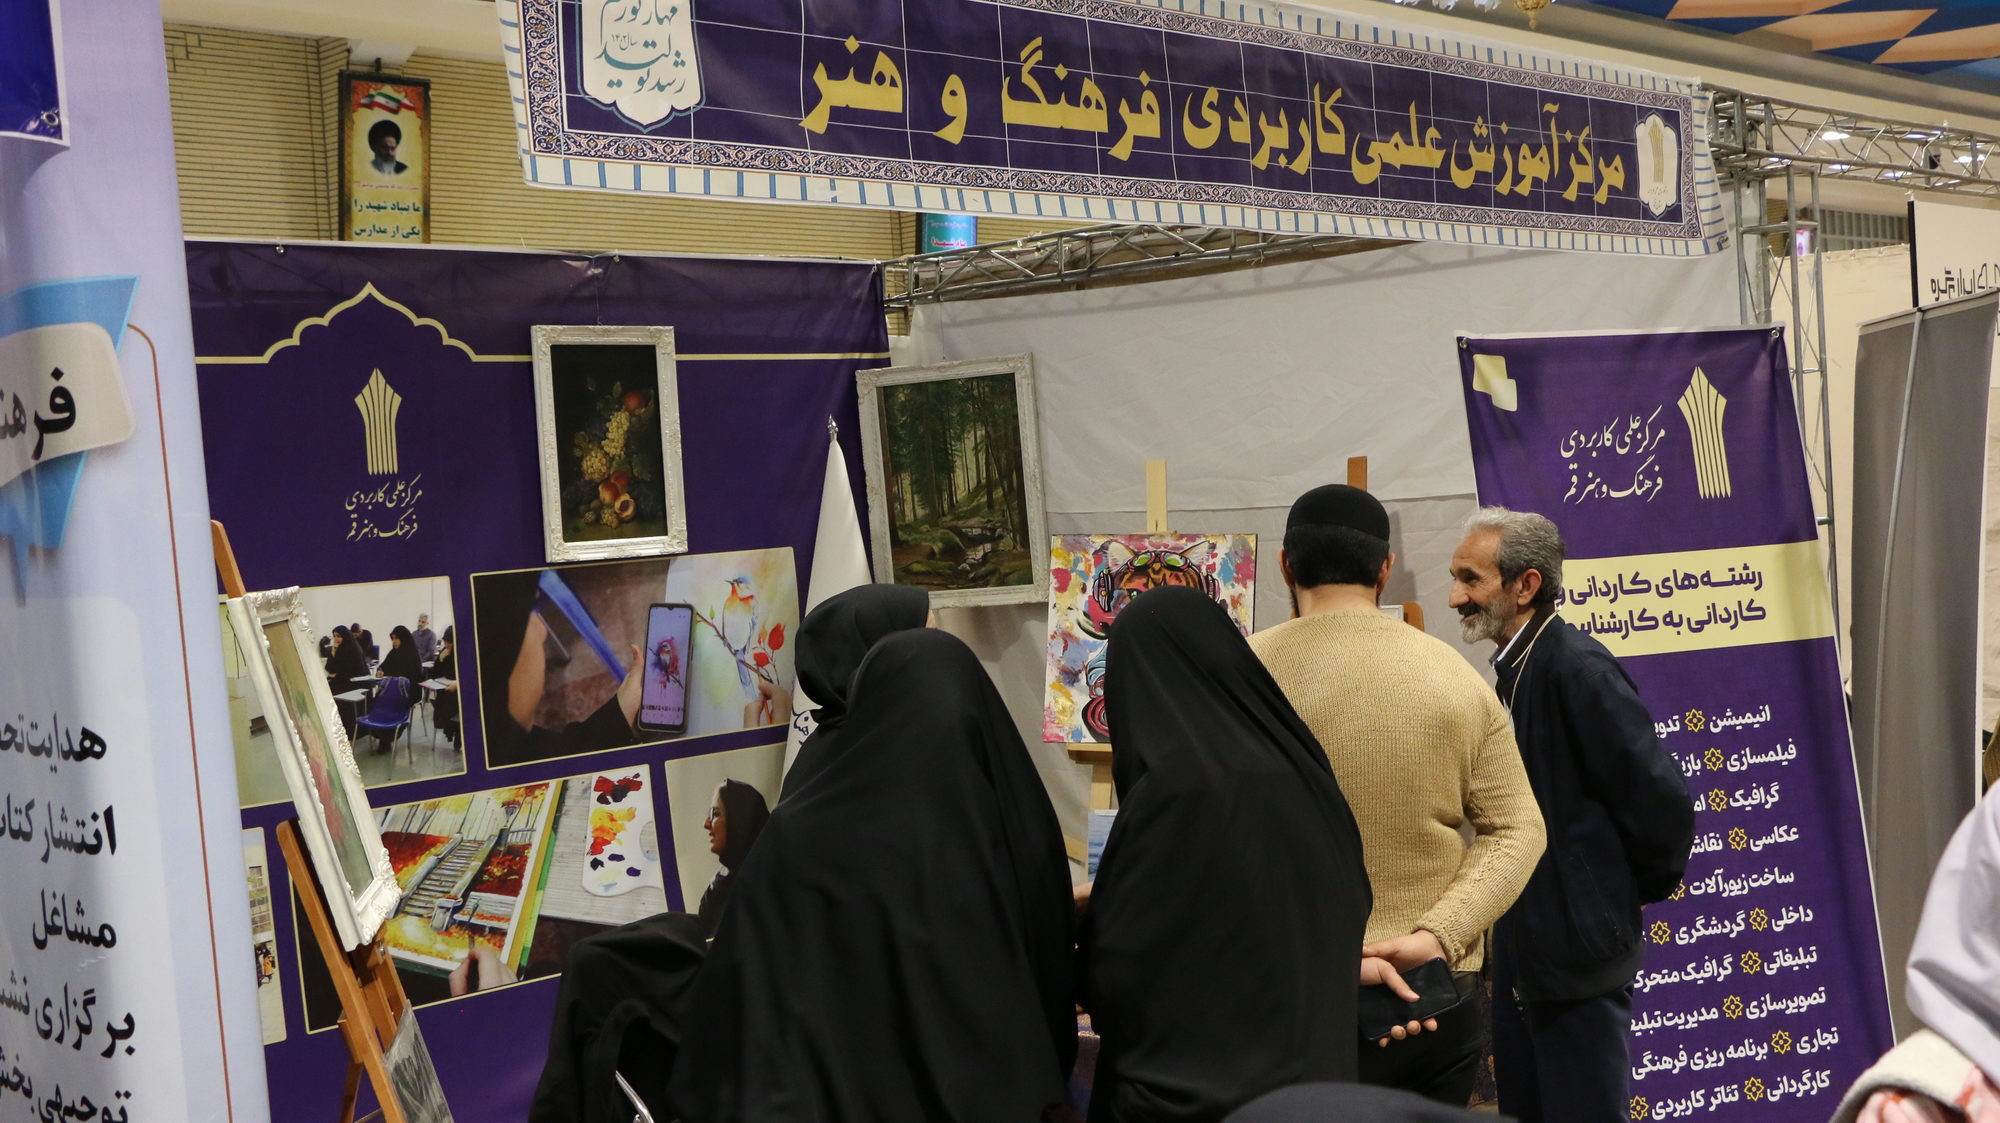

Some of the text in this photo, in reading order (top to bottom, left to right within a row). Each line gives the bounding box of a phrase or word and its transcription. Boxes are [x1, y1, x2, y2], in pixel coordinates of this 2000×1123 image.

[799, 35, 1626, 203] مرکز آموزش علمی کاربردی فرهنگ و هنر
[1560, 404, 1666, 458] مرکز علمی کاربردی
[345, 473, 423, 511] مرکز علمی کاربردی
[1576, 471, 1600, 505] هنر
[1609, 454, 1663, 502] فرهنگ
[378, 507, 418, 540] فرهنگ
[1569, 571, 1652, 606] کاردانی
[1581, 599, 1767, 640] کاردانی به کارشناس
[1654, 704, 1771, 739] انیمیشن تدوی
[27, 711, 107, 774] هدایت
[1726, 738, 1797, 772] فیلمسازی
[1729, 782, 1780, 811] گرافیک
[40, 800, 117, 864] انتشار
[1688, 825, 1799, 860] عکاسی نقاش
[1689, 866, 1795, 897] ساخت زیورآلات
[32, 888, 117, 950] مشاغل
[1675, 905, 1813, 945] داخلی گردشگری
[1681, 953, 1733, 984] گرافیک
[1763, 946, 1818, 975] تبلیغاتی
[1662, 1006, 1719, 1030] مدیریت
[1745, 987, 1827, 1020] تصویرسازی
[1632, 1027, 1839, 1080] تجاری برنامه ریزی فرهنگی
[1651, 1069, 1831, 1120] کارگردانی تئاتر کاربردی
